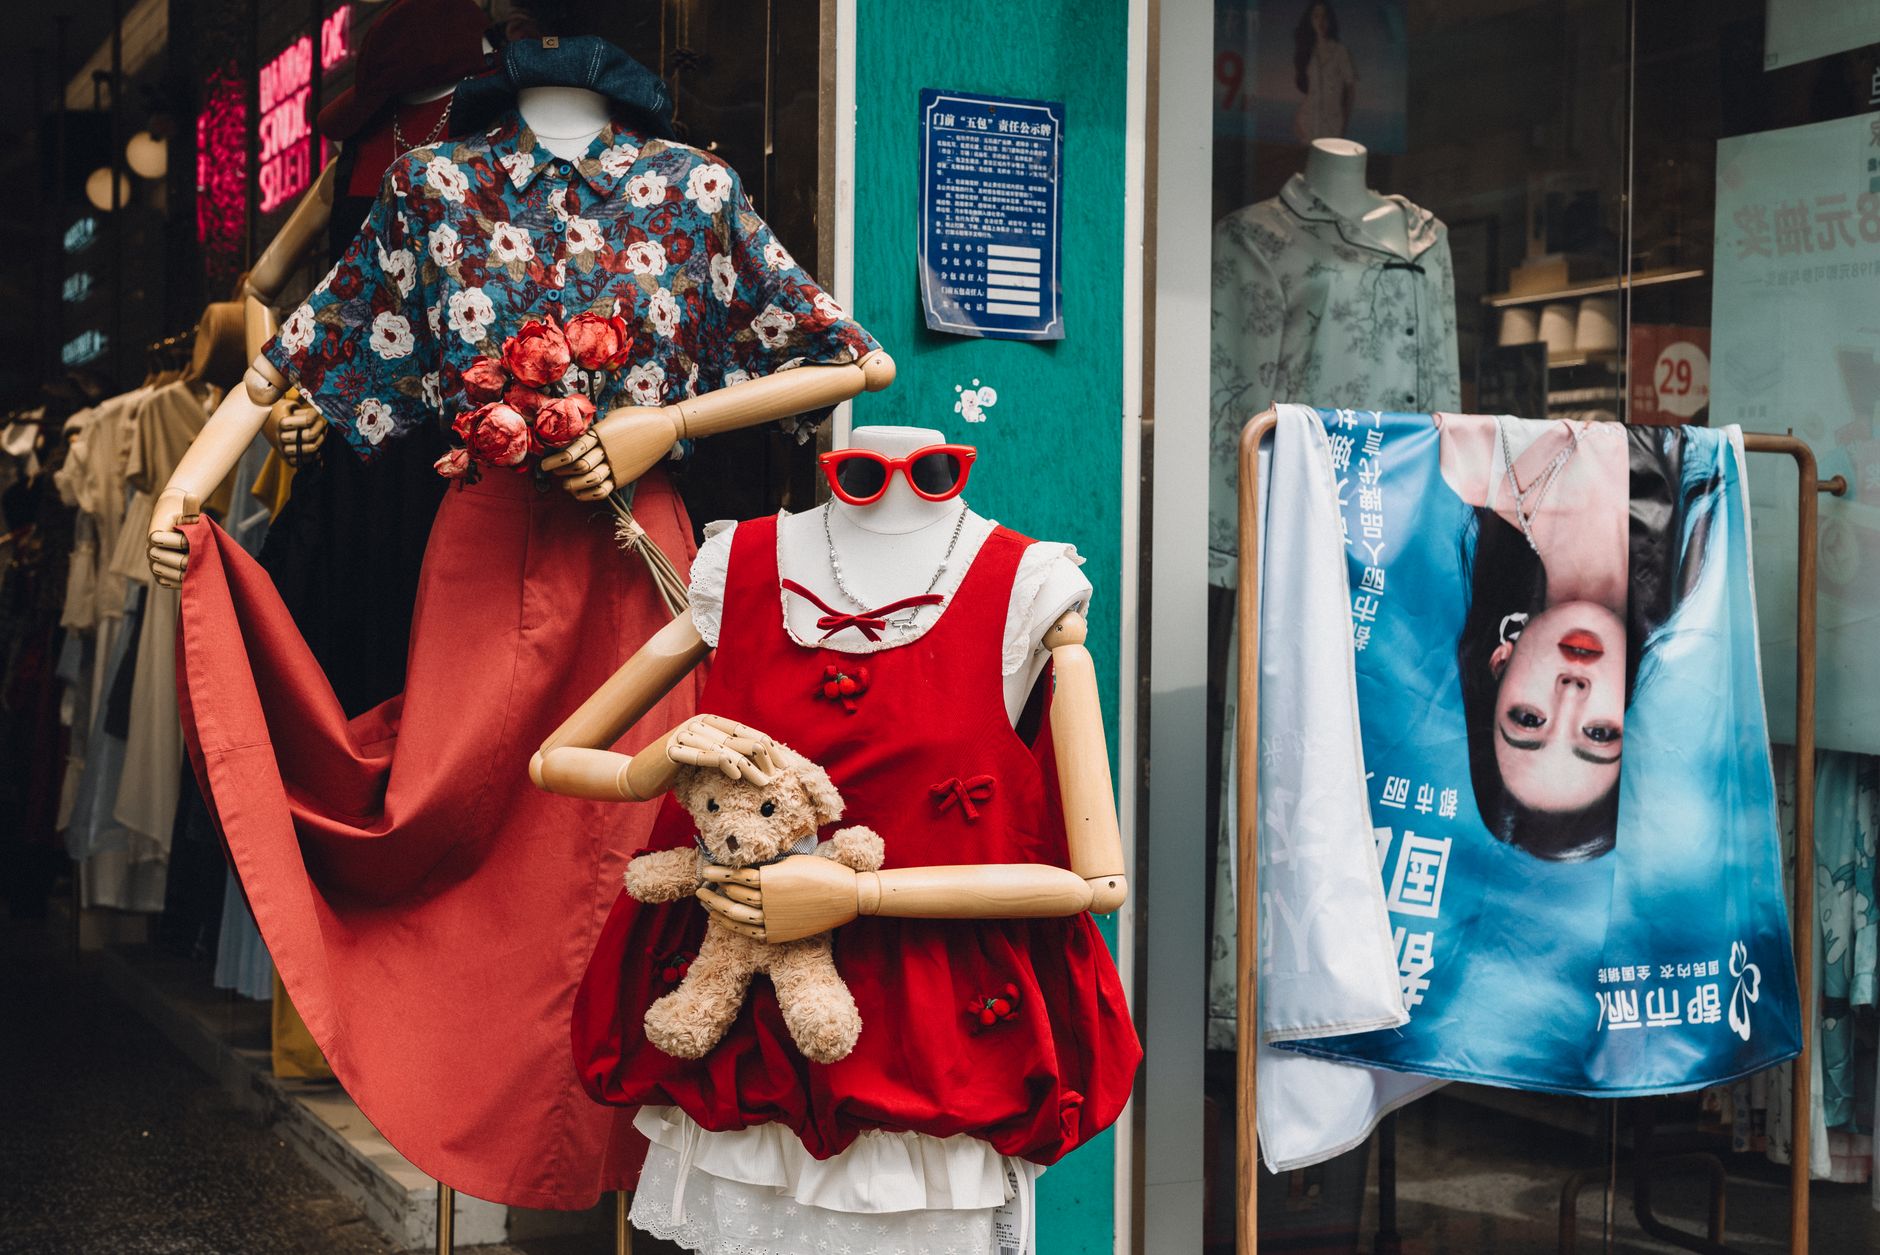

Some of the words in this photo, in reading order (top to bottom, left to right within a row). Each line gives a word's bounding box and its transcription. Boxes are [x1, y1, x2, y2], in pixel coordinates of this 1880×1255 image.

[1660, 357, 1692, 396] 29
[1366, 771, 1457, 820] 都市丽
[1660, 960, 1719, 978] 国民内衣
